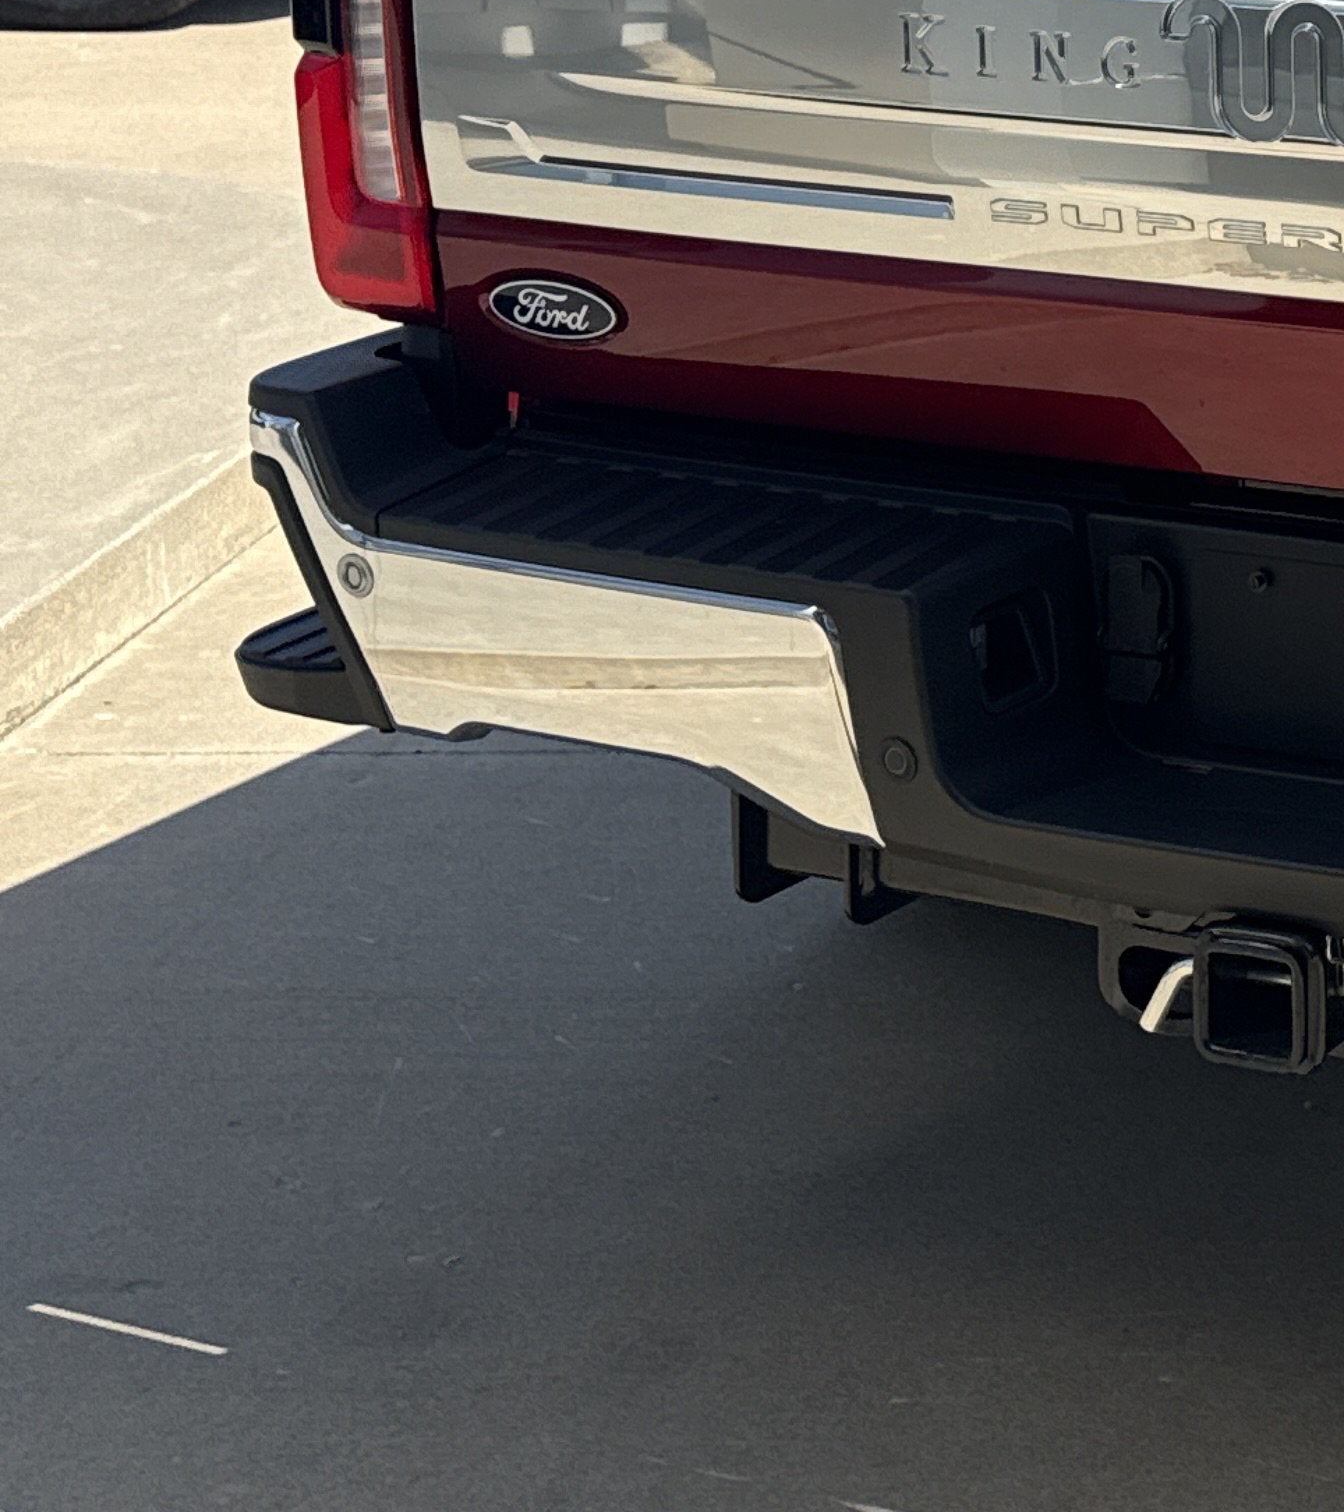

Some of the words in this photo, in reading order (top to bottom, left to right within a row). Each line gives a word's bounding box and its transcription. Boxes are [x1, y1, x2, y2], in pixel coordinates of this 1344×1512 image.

[899, 12, 1141, 89] KING
[990, 197, 1342, 252] SUPER
[513, 288, 590, 331] Ford
